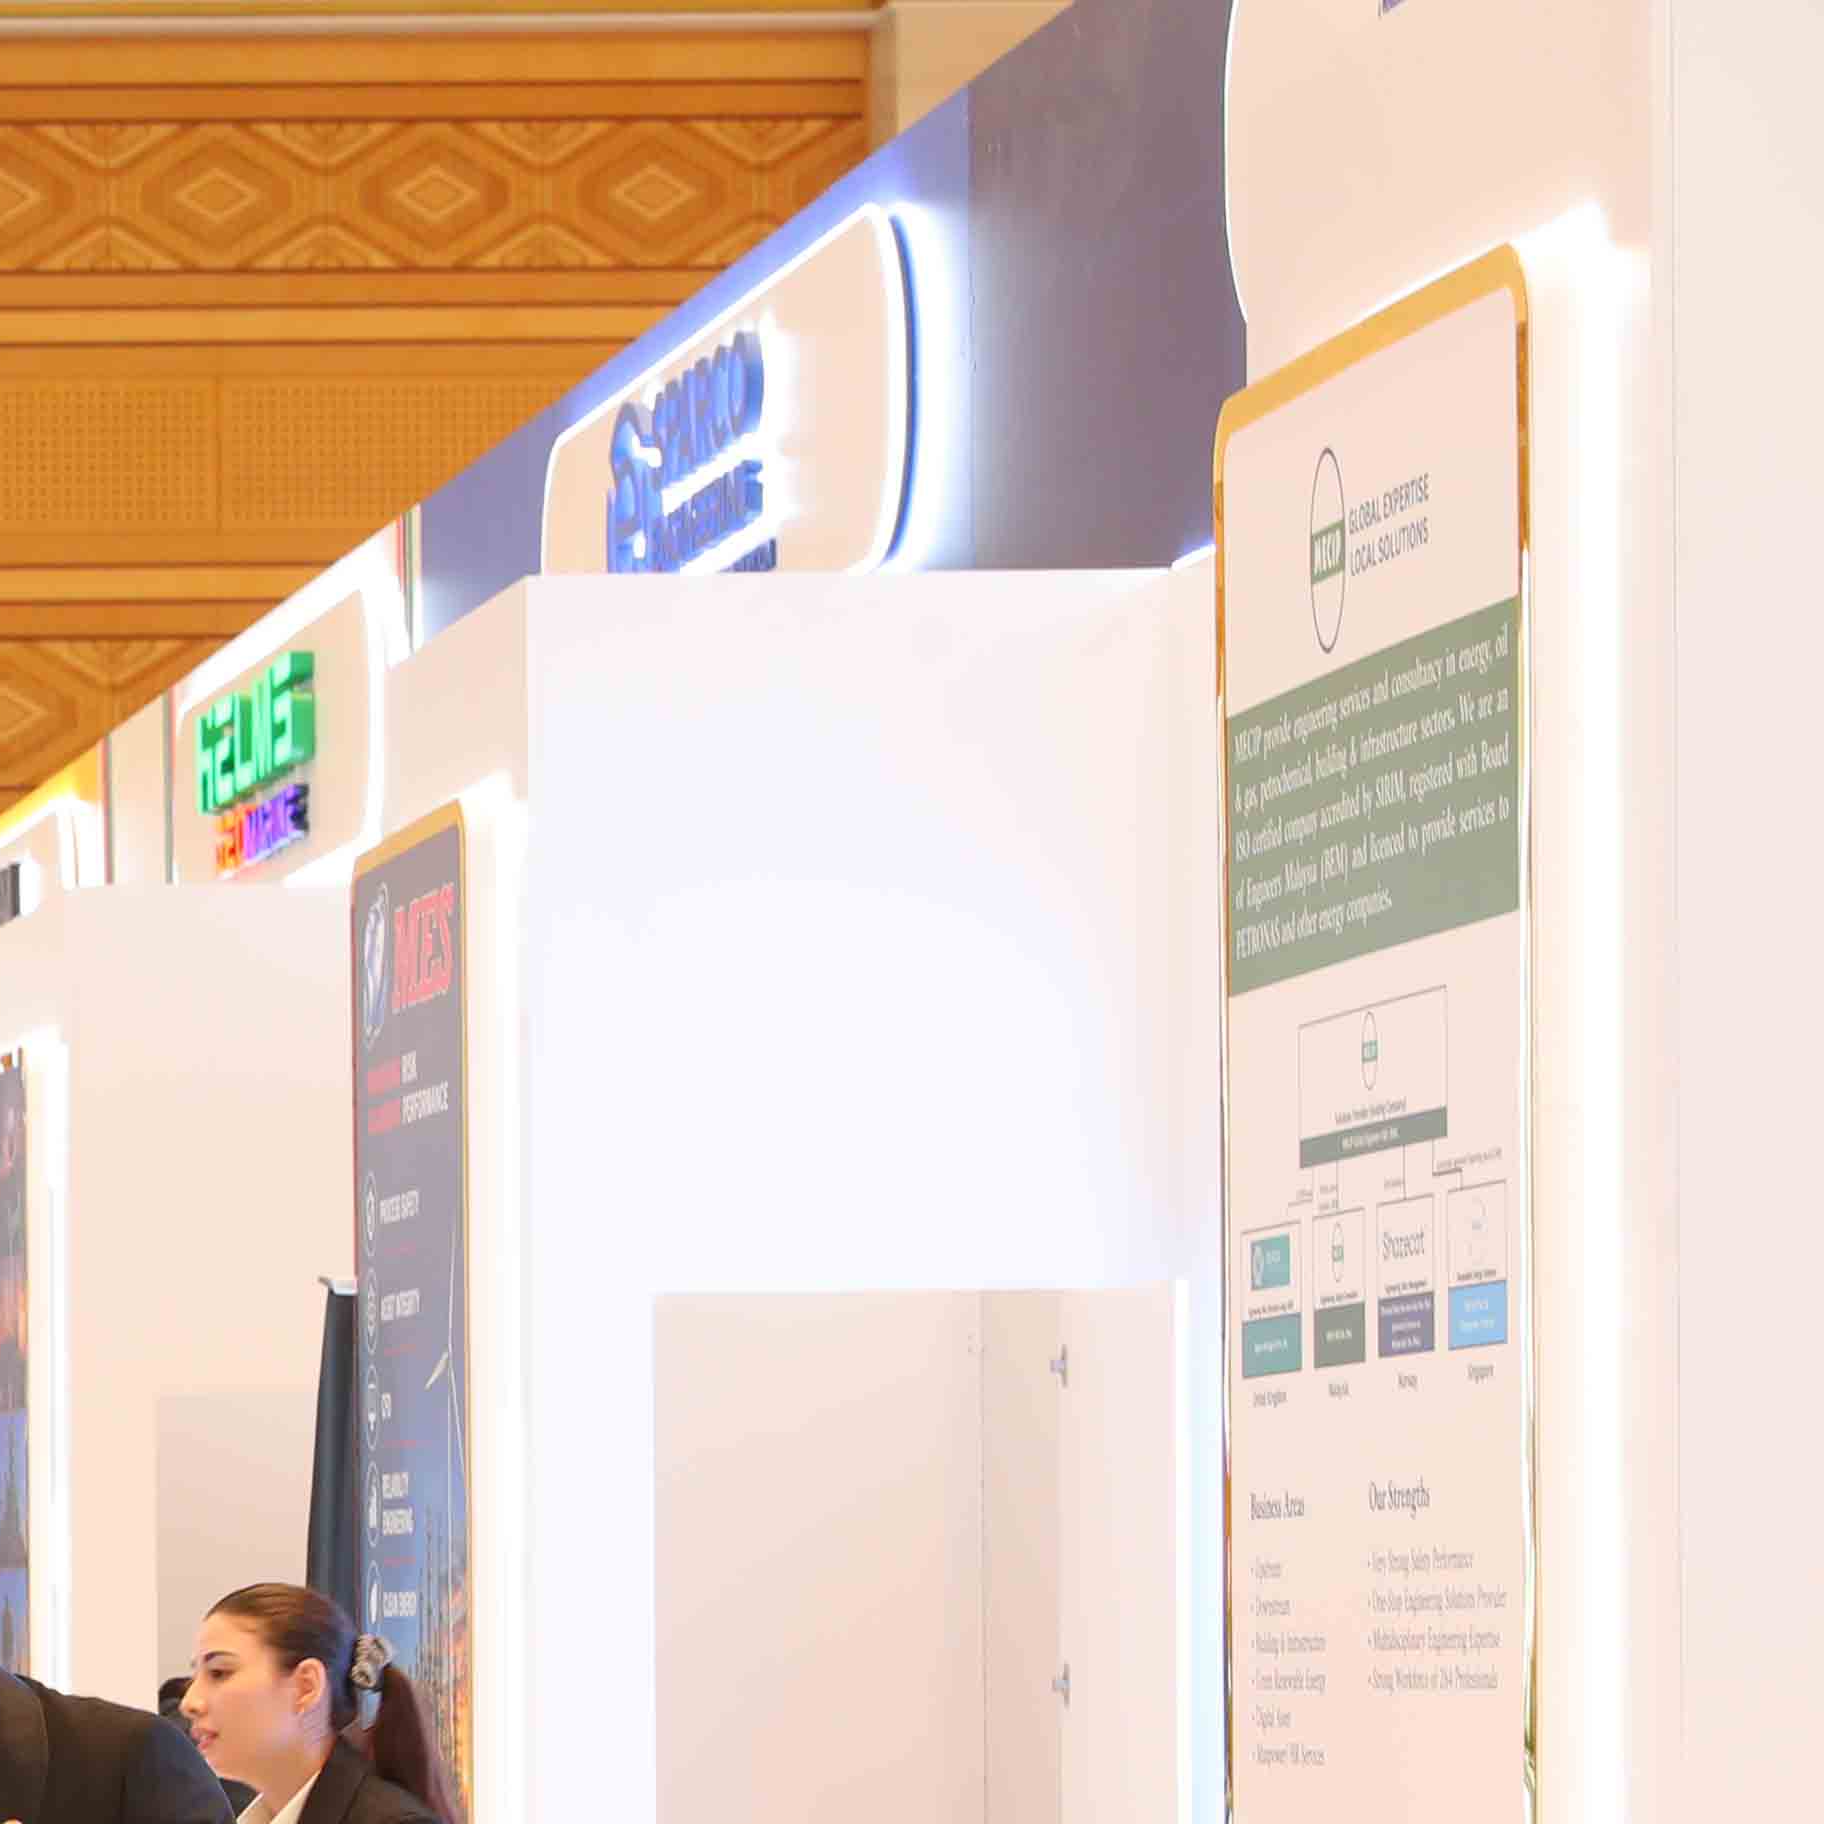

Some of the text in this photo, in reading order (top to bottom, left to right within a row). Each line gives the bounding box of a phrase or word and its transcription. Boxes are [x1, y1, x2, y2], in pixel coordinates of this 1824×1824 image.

[1349, 475, 1430, 536] GLOBAL EXPERTISE
[1351, 519, 1430, 578] LOCAL SOLUTIONS
[1234, 728, 1261, 767] MECIP
[1263, 716, 1291, 755] provide
[1294, 700, 1337, 744] engineering
[1337, 688, 1370, 716] services
[1372, 671, 1389, 706] and
[1392, 660, 1441, 700] consultancy
[1444, 650, 1456, 677] in
[1495, 625, 1509, 659] oil
[1359, 718, 1418, 763] infrastructure
[1456, 693, 1474, 724] We
[1477, 698, 1493, 720] are
[1495, 690, 1509, 714] an
[1235, 832, 1250, 863] ISO
[1320, 788, 1359, 831] accredited
[1362, 786, 1373, 820] by
[1409, 753, 1453, 801] registered
[1456, 744, 1478, 779] with
[1481, 733, 1509, 771] Board
[1235, 879, 1244, 912] of
[1247, 866, 1283, 912] Engineers
[1352, 834, 1368, 870] and
[1408, 820, 1419, 851] to
[1422, 809, 1456, 857] provide
[1459, 799, 1495, 836] services
[1499, 797, 1510, 822] to
[392, 882, 455, 1014] MES
[1235, 917, 1280, 961] PETRONAS
[1281, 913, 1296, 949] and
[1297, 905, 1318, 941] other
[1319, 899, 1344, 938] energy
[402, 1051, 417, 1083] RISK
[402, 1081, 449, 1123] PERFORMANCE
[1250, 1492, 1305, 1521] Business Areas
[1369, 1477, 1431, 1521] Our Strengths
[1372, 1548, 1473, 1580] Very Strong Safety Performance
[1404, 1589, 1442, 1619] Engineering
[1444, 1587, 1476, 1614] Solutions
[1477, 1585, 1508, 1611] Provider
[1427, 1628, 1467, 1658] Engineering
[1468, 1626, 1501, 1656] Expertise
[1303, 1670, 1327, 1697] Energy
[1371, 1670, 1393, 1698] Strong
[1394, 1668, 1429, 1693] Workforce
[1454, 1665, 1498, 1692] Professionals
